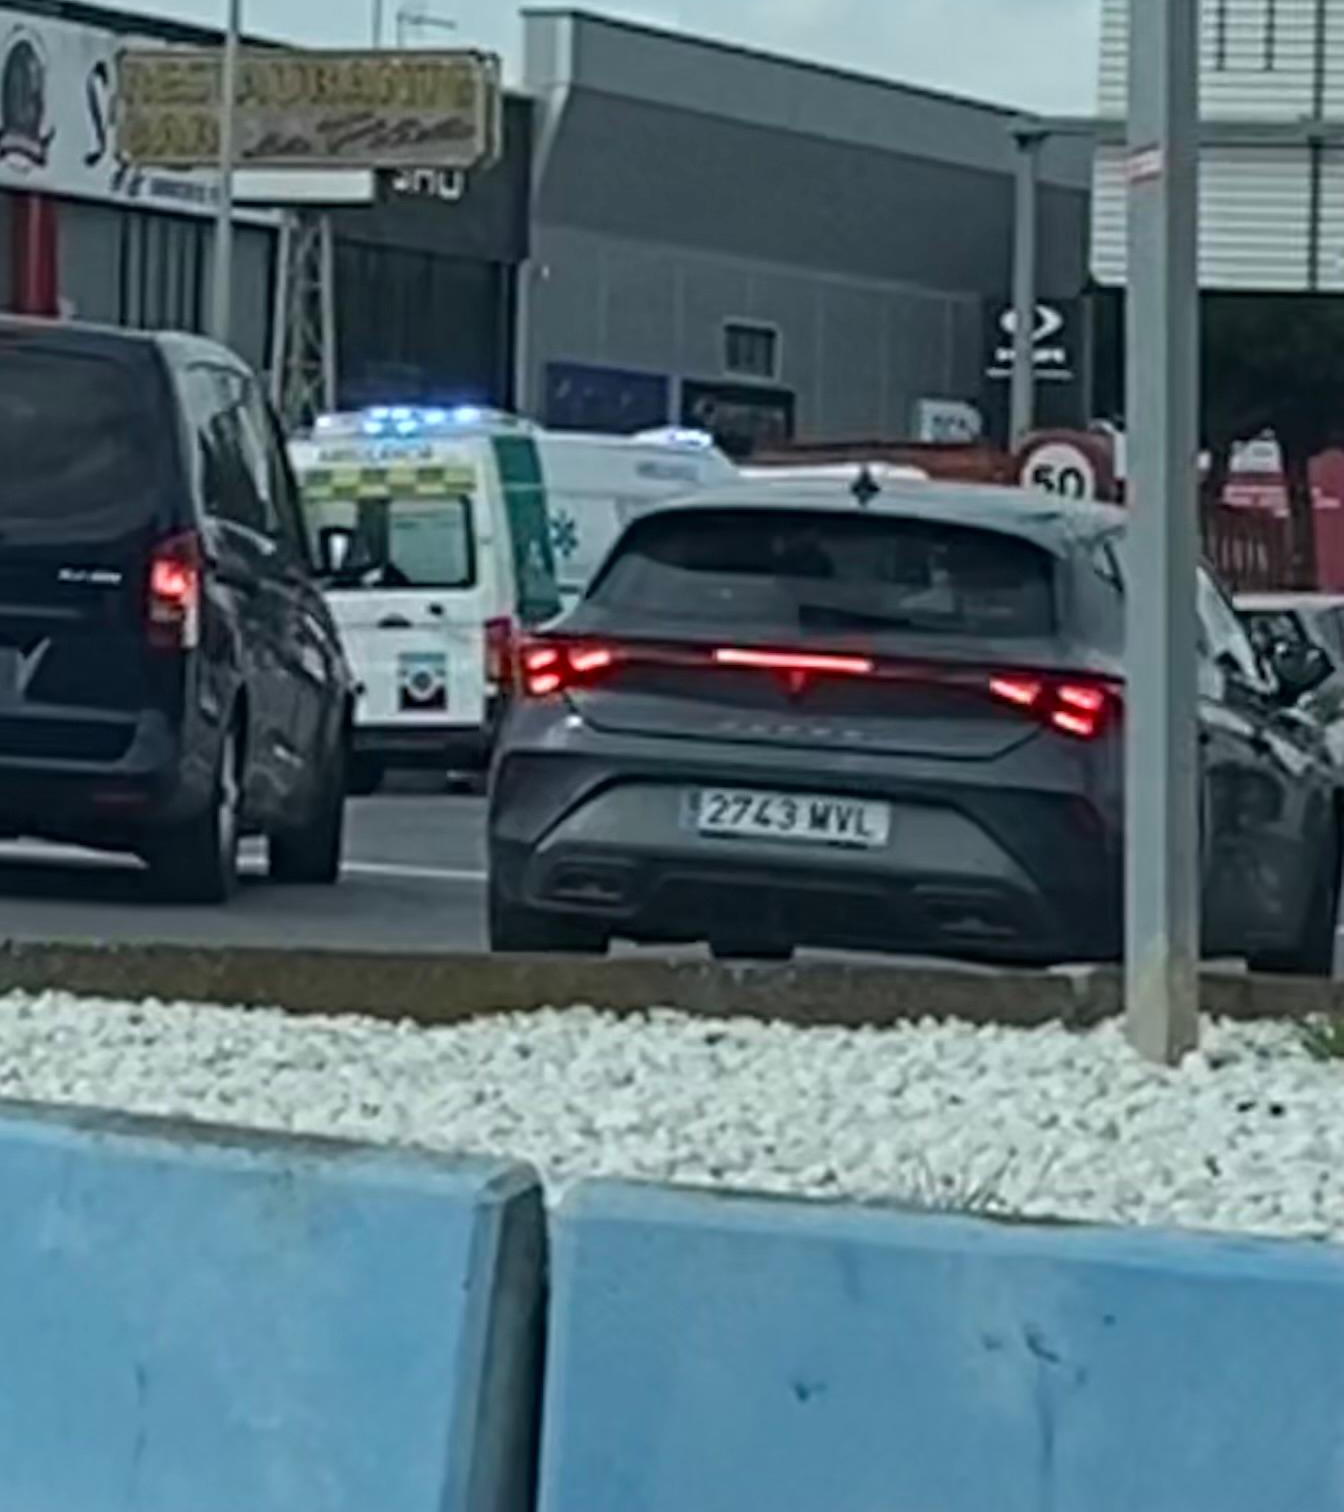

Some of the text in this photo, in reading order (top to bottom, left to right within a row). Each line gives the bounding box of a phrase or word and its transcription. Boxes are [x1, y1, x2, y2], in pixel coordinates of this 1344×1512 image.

[1032, 463, 1086, 500] 50
[707, 792, 874, 837] 2743 MVL
